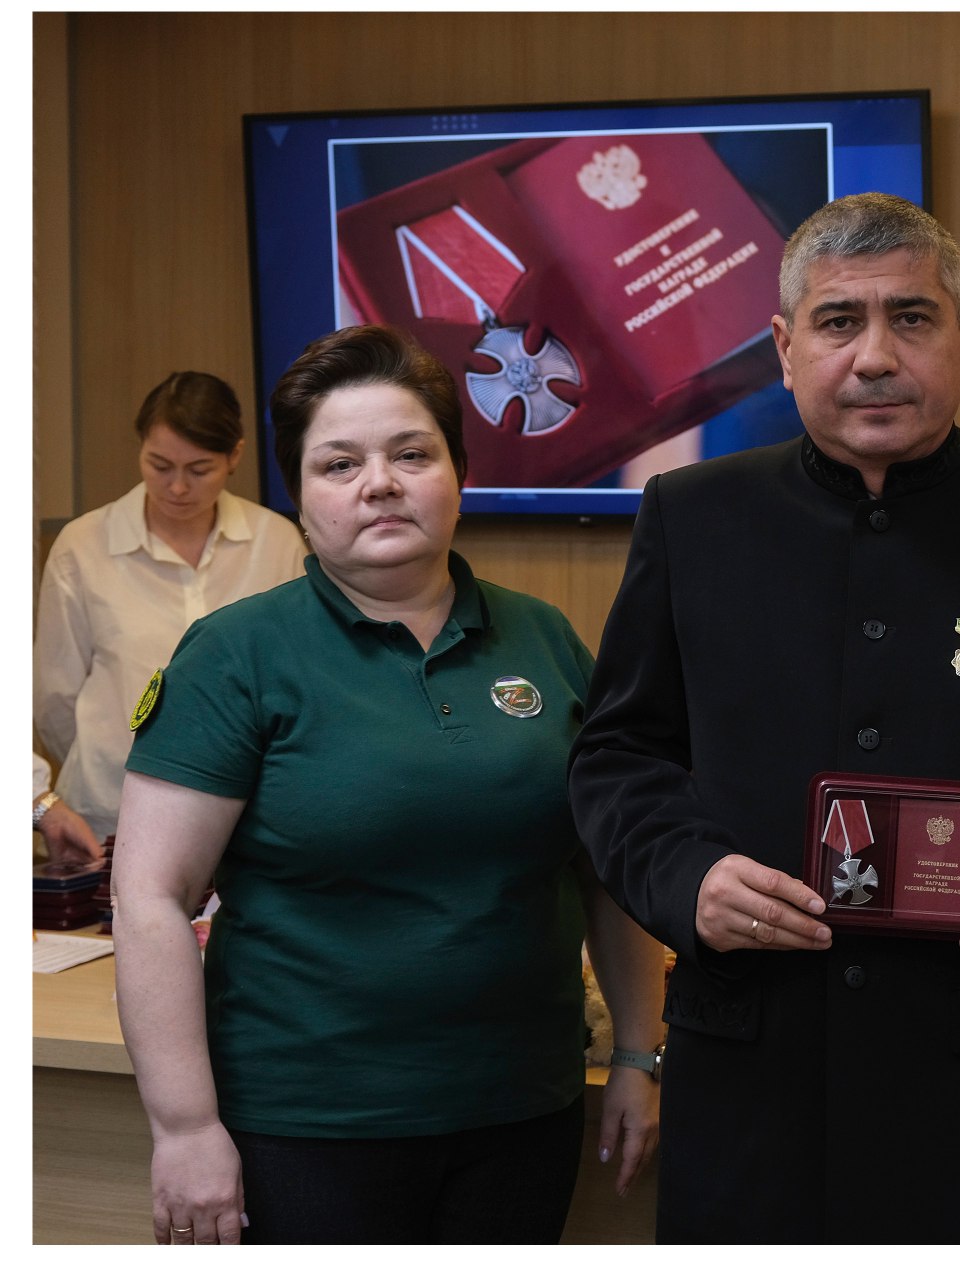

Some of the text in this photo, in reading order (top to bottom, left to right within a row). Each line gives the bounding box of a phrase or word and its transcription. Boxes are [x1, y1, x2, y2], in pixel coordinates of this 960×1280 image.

[624, 241, 759, 332] РОССИЙСКОЙ ФЕДЕРАЦИИ
[657, 257, 708, 293] НАГРАДЕ
